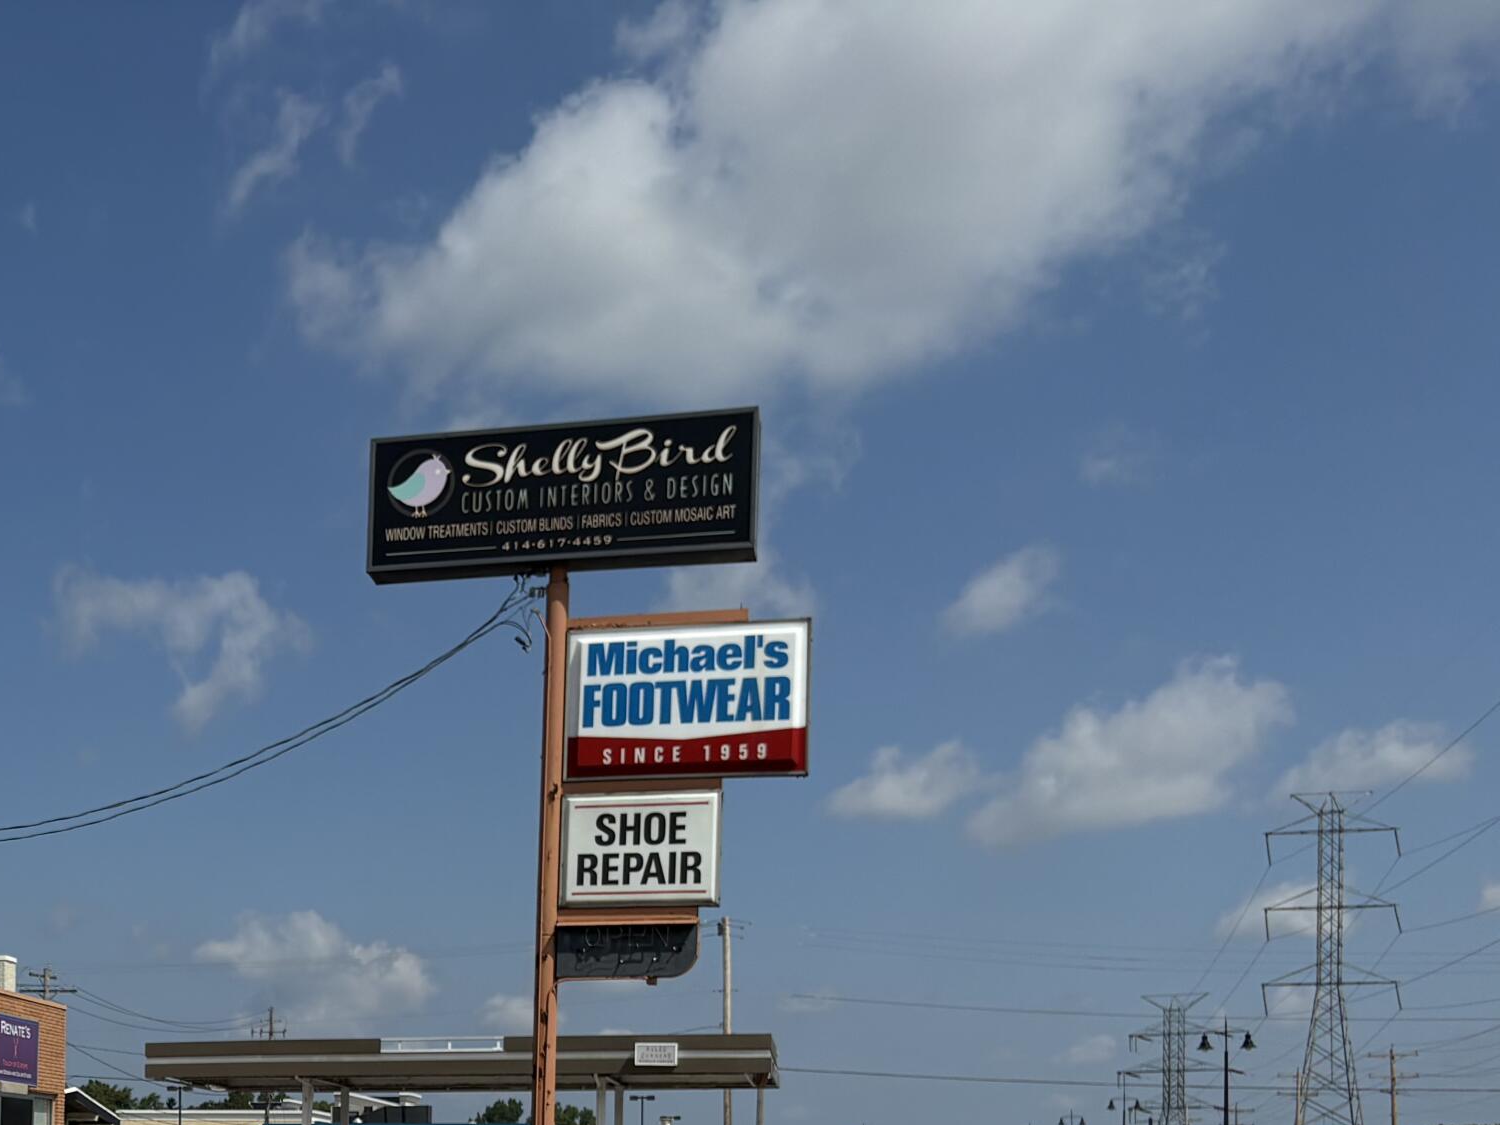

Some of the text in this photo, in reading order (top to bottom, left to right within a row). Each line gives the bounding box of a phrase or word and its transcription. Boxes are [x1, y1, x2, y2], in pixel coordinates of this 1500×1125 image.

[461, 472, 734, 514] CUSTOM INTERIORS & DESIGN
[385, 504, 737, 542] WINDOW TREATMENTS CUSTOM BLINDS FABRICS CUSTOM MOSAIC ART
[586, 633, 790, 677] Michael's
[581, 676, 792, 728] FOOTWEAR
[602, 742, 769, 766] SINCE 1959
[594, 811, 687, 847] SHOE
[575, 851, 703, 887] REPAIR
